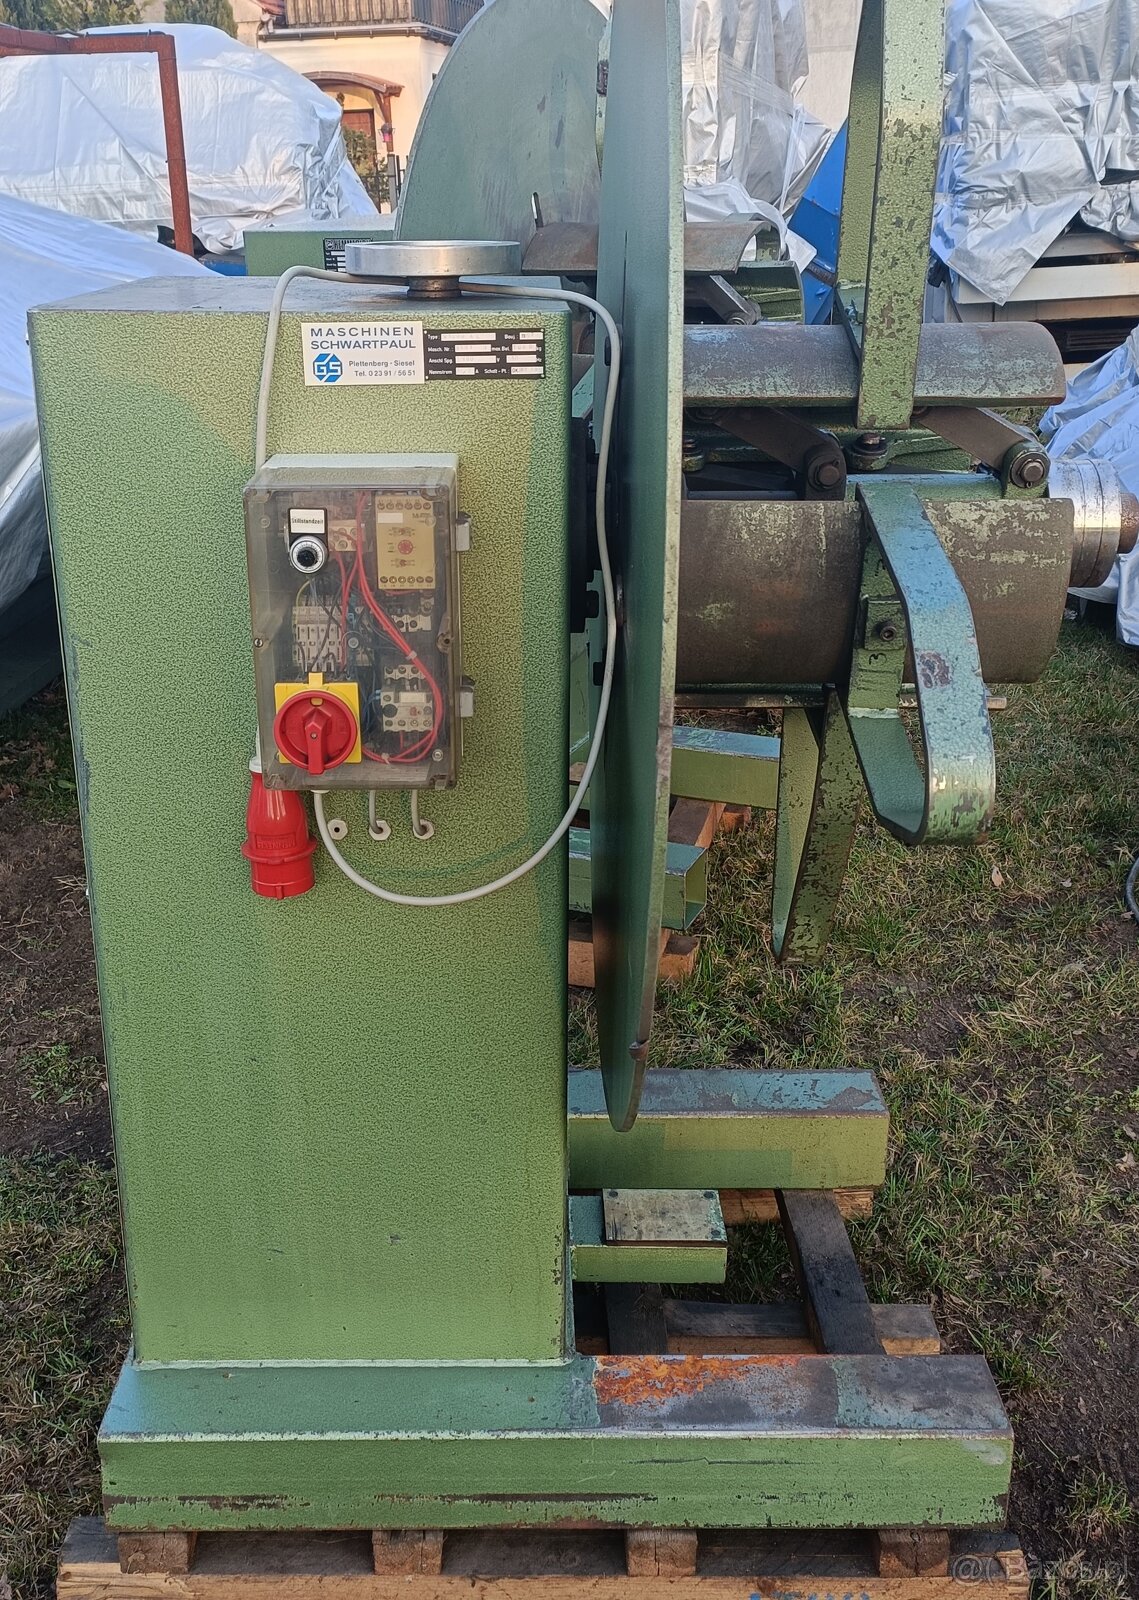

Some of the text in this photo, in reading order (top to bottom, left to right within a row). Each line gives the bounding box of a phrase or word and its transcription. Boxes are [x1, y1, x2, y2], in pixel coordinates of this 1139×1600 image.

[311, 327, 414, 337] MASCHINEN
[311, 340, 416, 349] SCHWARTPAUL
[348, 359, 389, 367] Plettenberg
